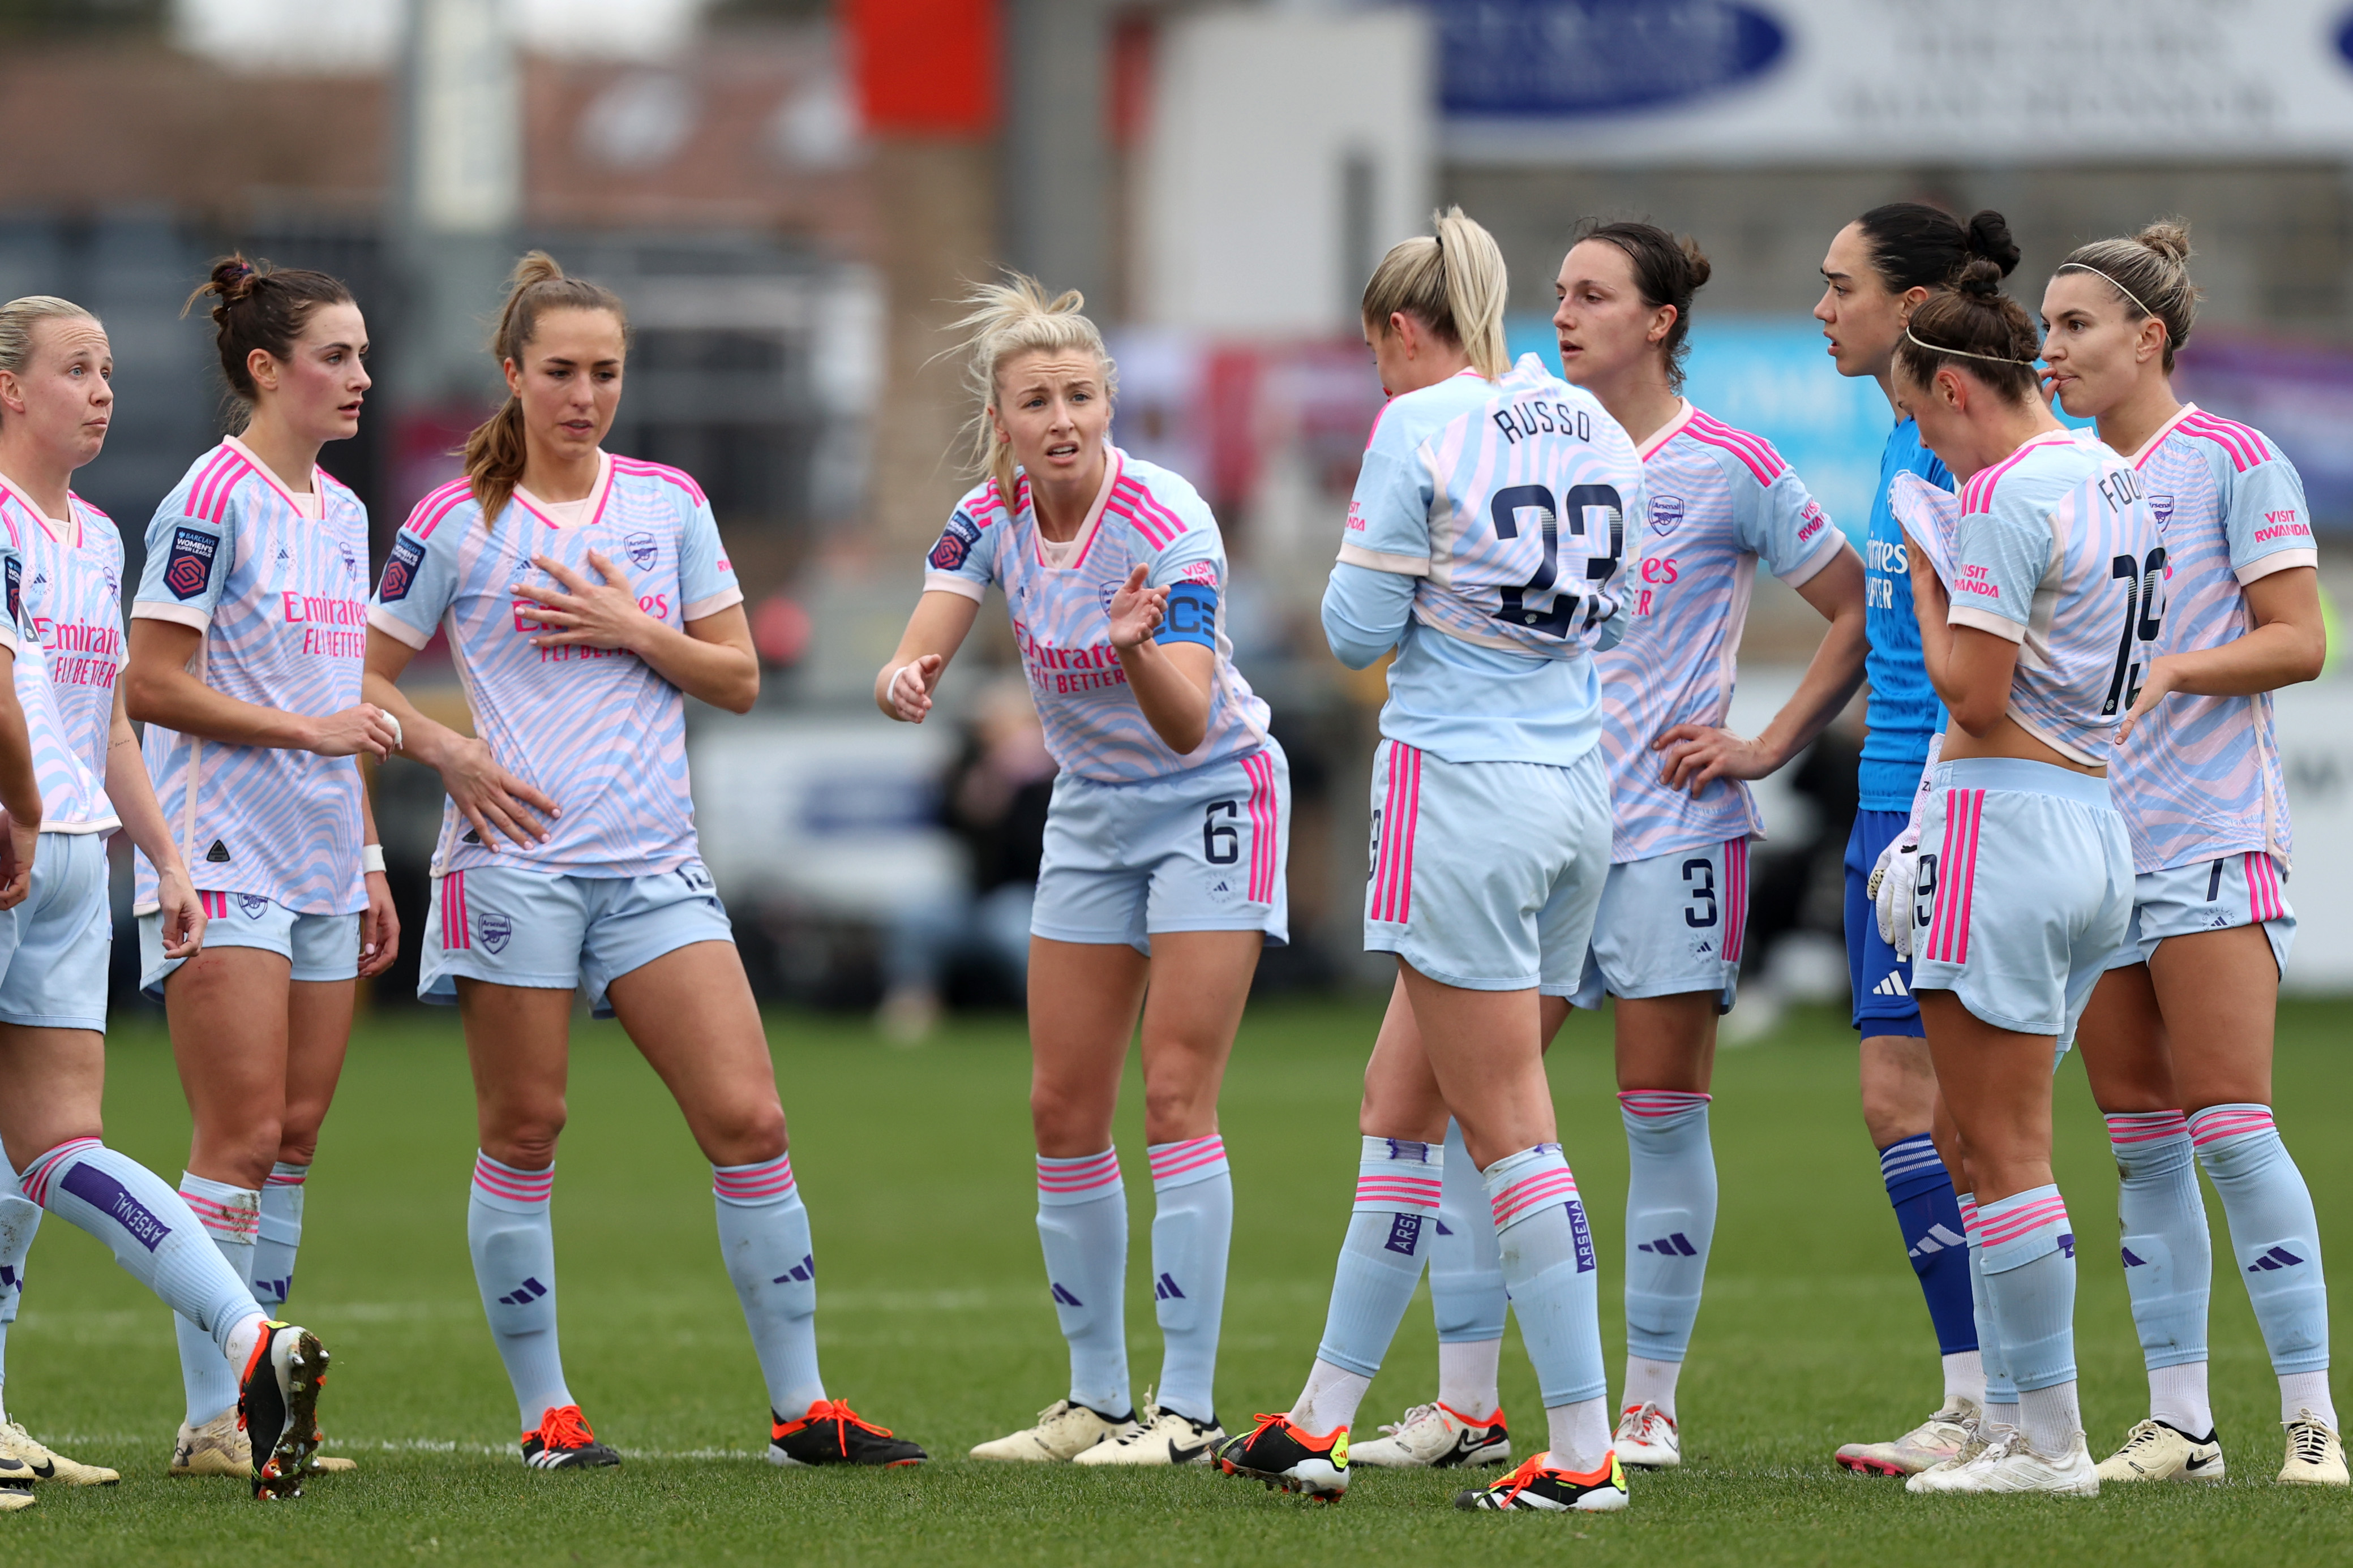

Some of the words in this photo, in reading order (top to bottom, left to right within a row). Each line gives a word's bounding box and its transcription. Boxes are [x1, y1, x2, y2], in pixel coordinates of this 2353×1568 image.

[1493, 401, 1589, 445] RUSSO
[2097, 468, 2145, 514] FOO
[2254, 523, 2310, 543] RWANDA
[2264, 510, 2295, 524] VISIT
[175, 544, 192, 553] SUPER
[177, 538, 213, 553] WOMEN'S
[186, 532, 216, 547] BARCLAYS
[1182, 561, 1211, 577] VISIT
[1491, 484, 1623, 639] 23
[1169, 596, 1201, 633] C
[32, 617, 120, 656] Emirate
[303, 628, 325, 655] FLY
[327, 630, 366, 659] BETTER
[54, 656, 75, 684] FLY
[1056, 668, 1127, 694] BETTER
[1203, 800, 1238, 865] 6
[1682, 858, 1718, 928] 3
[112, 1192, 165, 1243] ARSENAL
[1570, 1201, 1593, 1266] ARSENA
